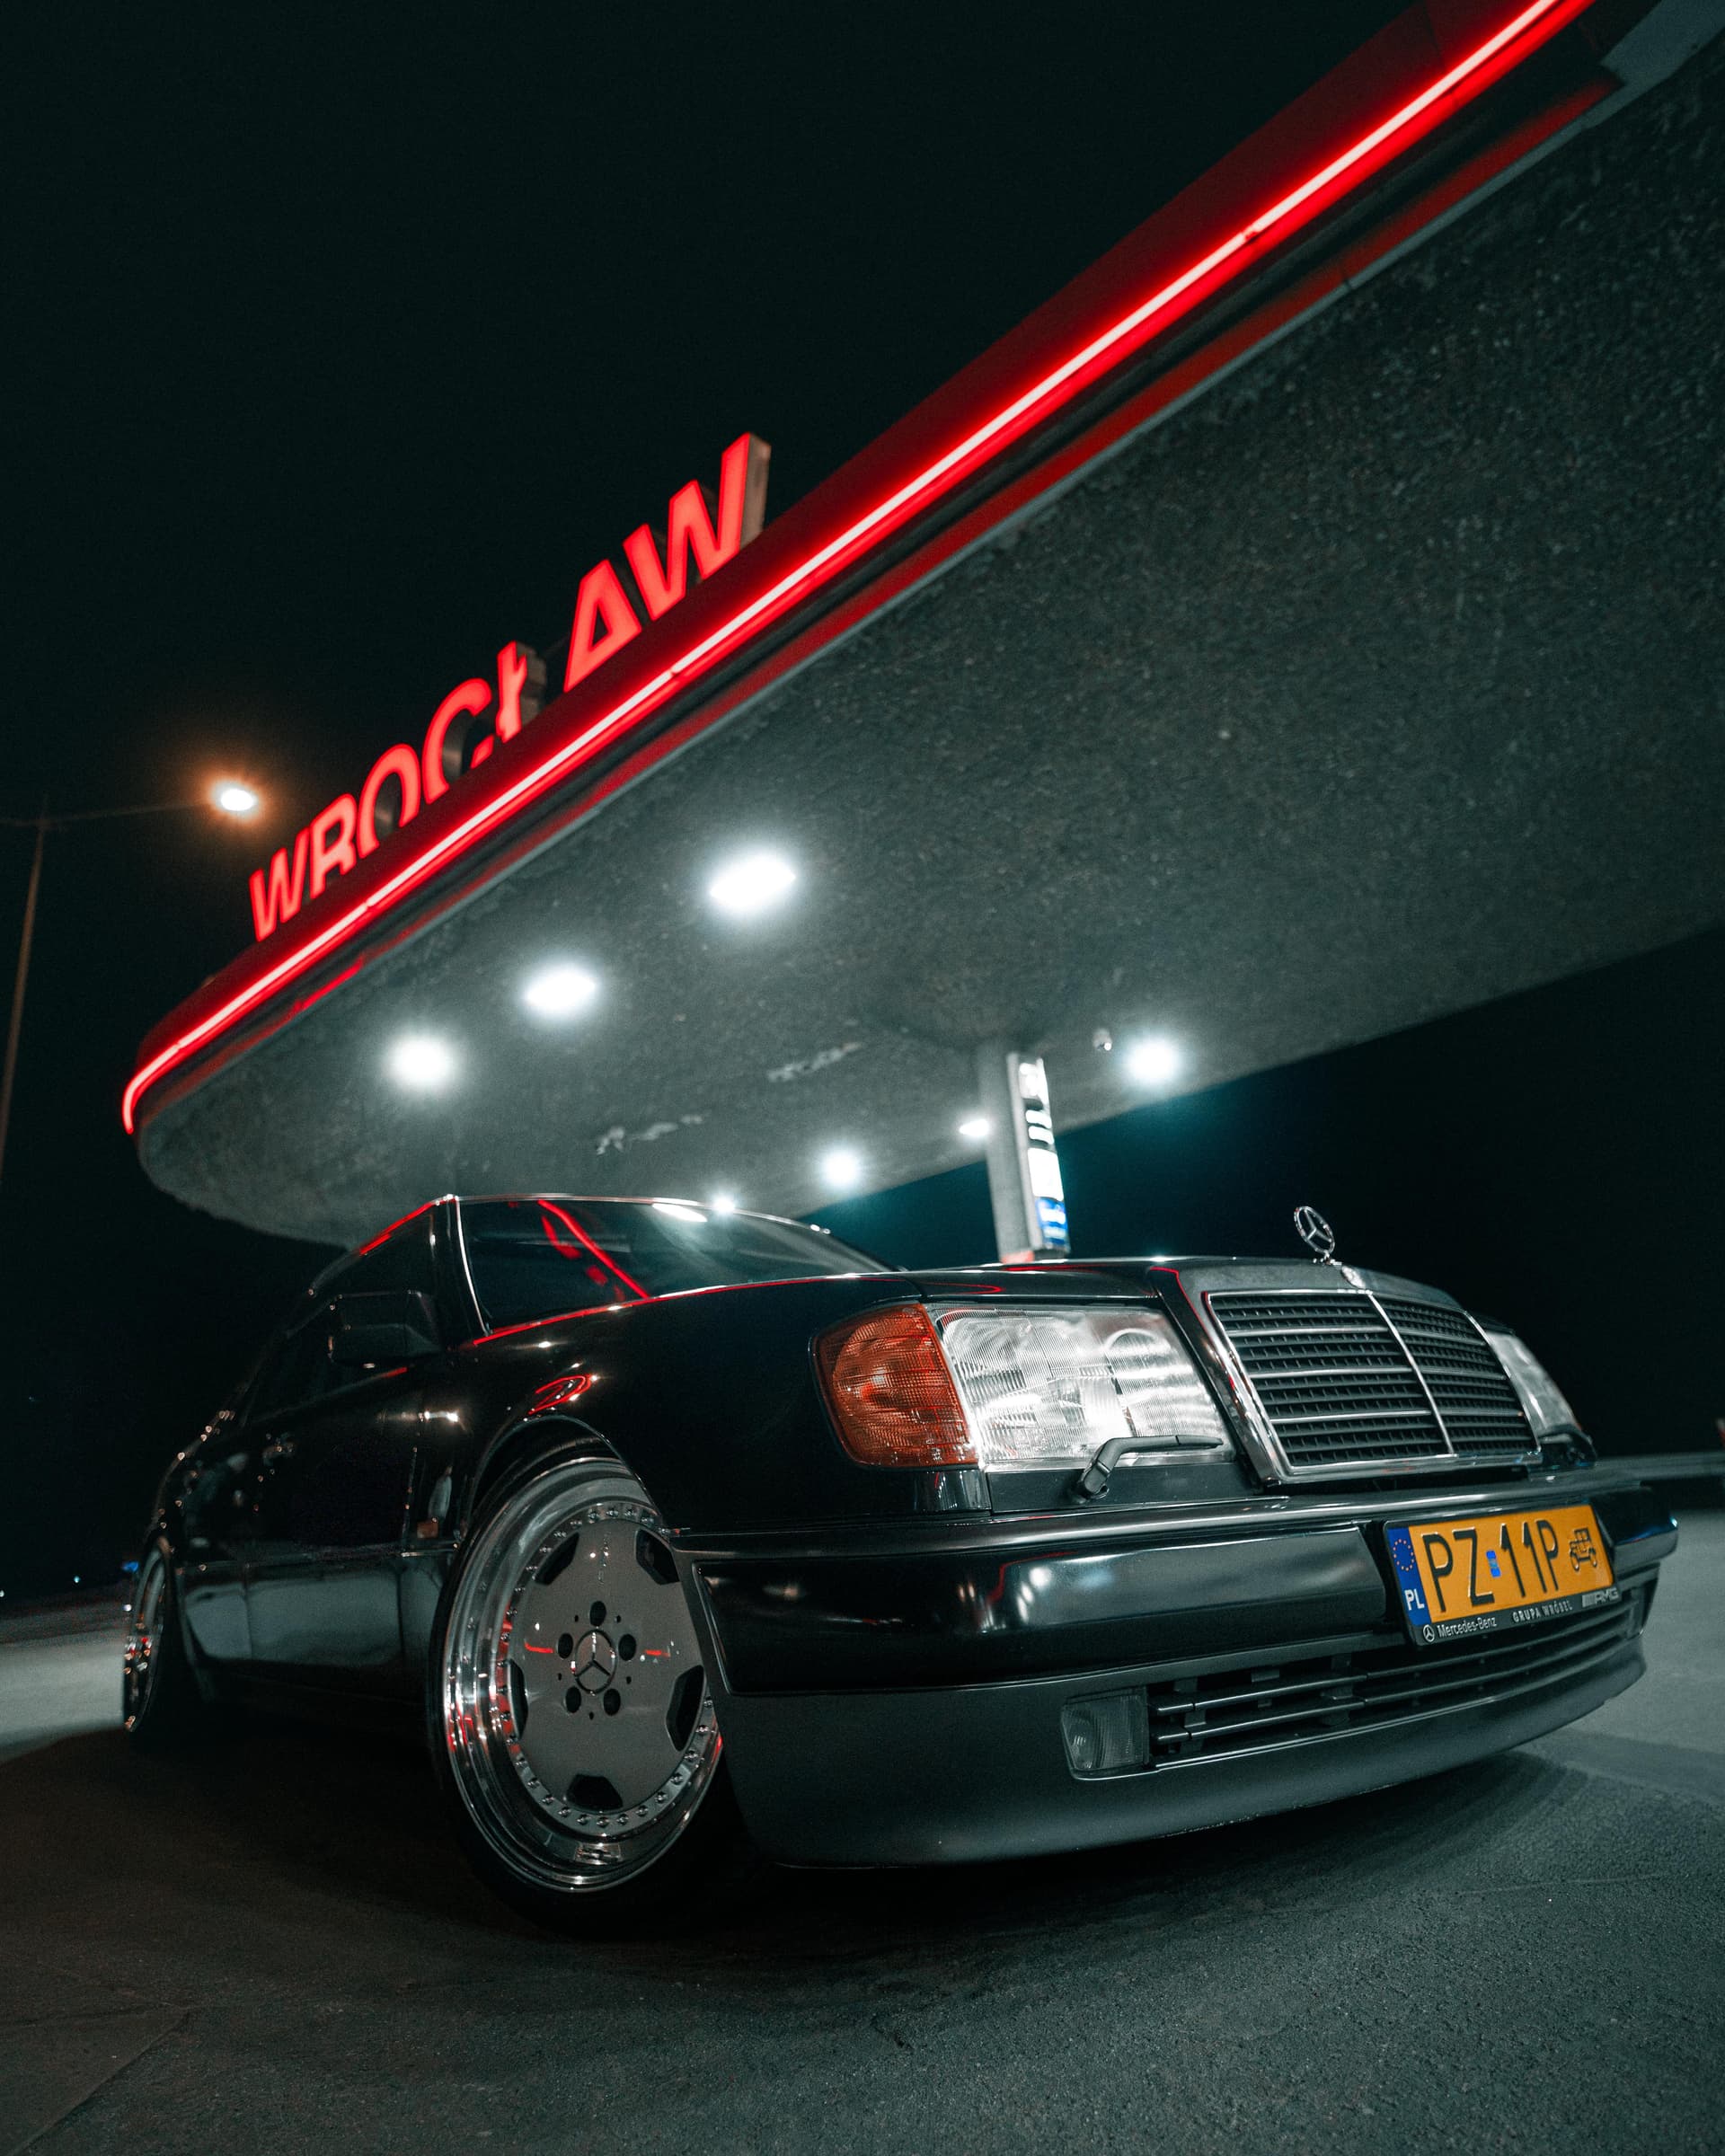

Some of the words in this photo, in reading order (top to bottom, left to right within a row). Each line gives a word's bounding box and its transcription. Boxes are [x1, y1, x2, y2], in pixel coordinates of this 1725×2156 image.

[249, 433, 762, 941] WROCŁAW
[1421, 1527, 1495, 1613] PZ
[1499, 1520, 1559, 1597] 11P
[1404, 1588, 1425, 1611] PL
[1512, 1608, 1542, 1622] GRUPA
[1438, 1617, 1498, 1638] Mercedes-Benz
